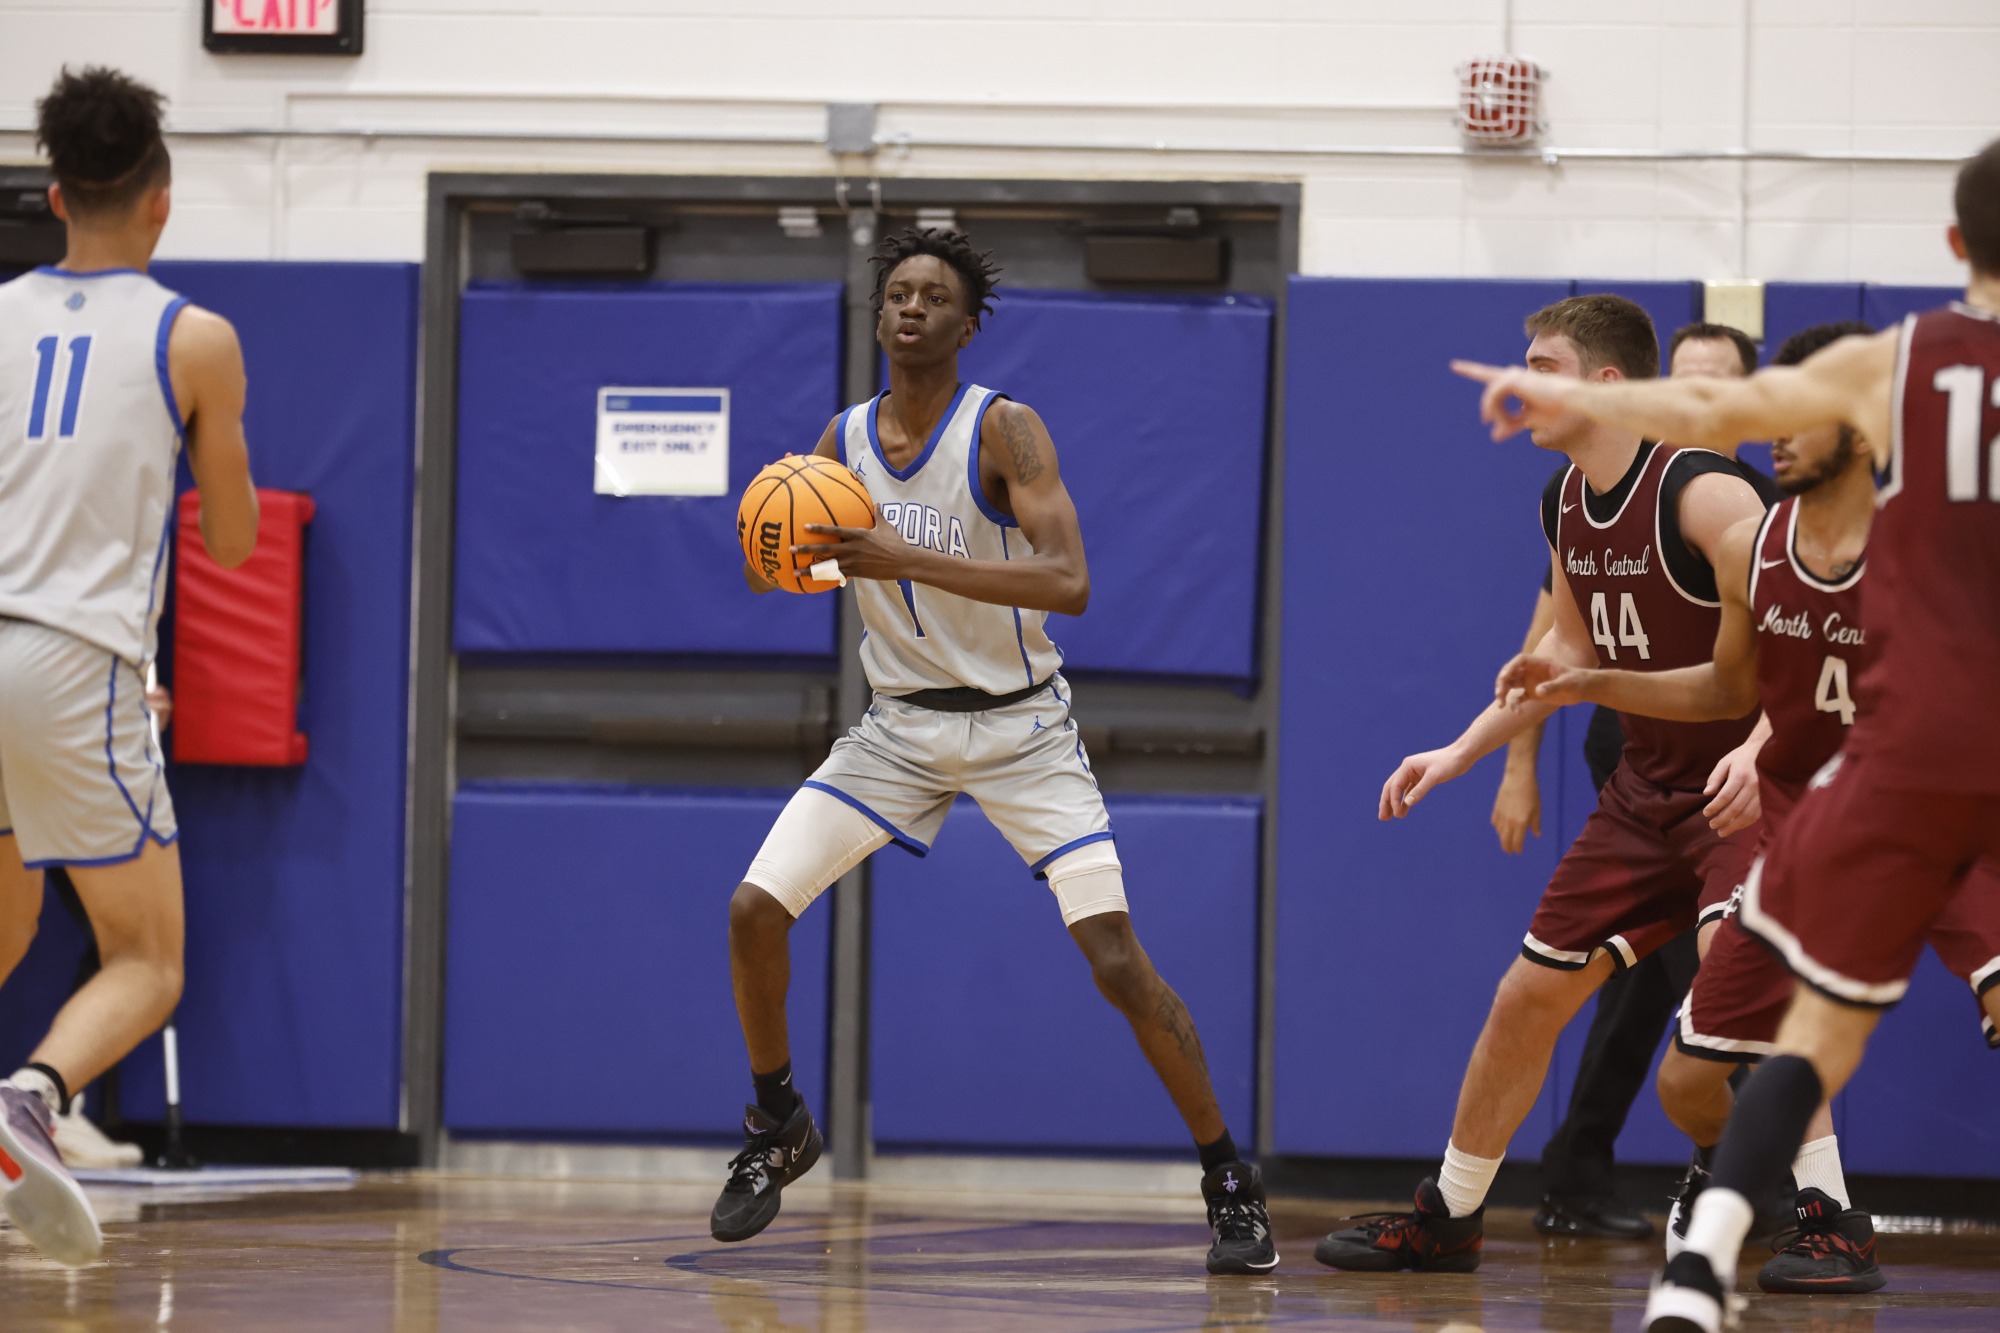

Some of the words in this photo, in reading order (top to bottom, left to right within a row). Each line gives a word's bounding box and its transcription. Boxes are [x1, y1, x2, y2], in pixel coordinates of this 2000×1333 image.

[25, 334, 94, 441] 11
[1933, 364, 2000, 502] 1
[759, 521, 783, 583] Wilso
[881, 502, 971, 560] RORA
[1566, 545, 1599, 576] North
[1604, 544, 1650, 577] Central
[1590, 591, 1651, 661] 44
[1757, 604, 1813, 640] North
[1814, 655, 1857, 725] 4
